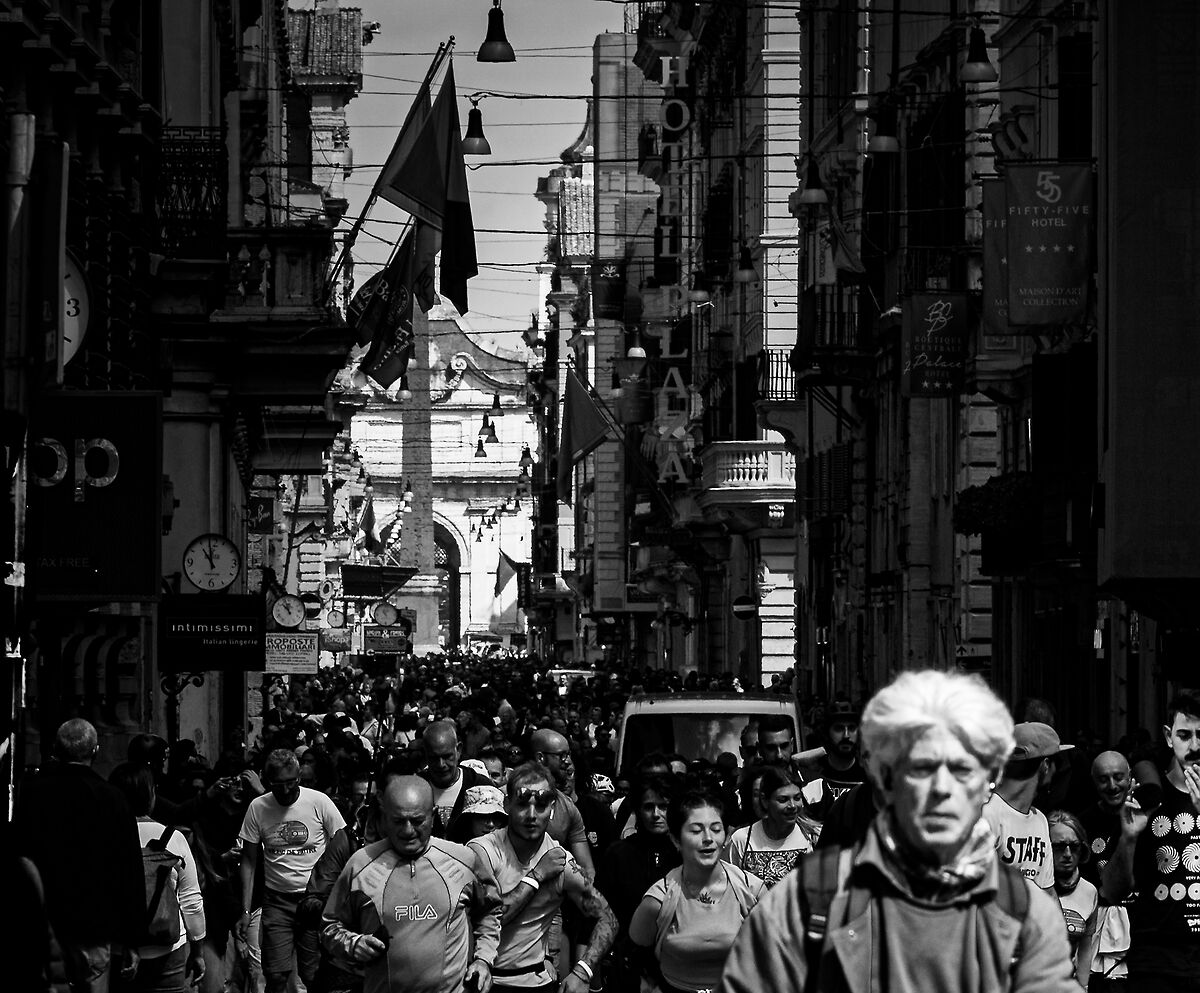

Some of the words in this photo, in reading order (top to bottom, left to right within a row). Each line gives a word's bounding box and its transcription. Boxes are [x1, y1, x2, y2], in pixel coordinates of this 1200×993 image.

[1036, 171, 1062, 203] 55
[1031, 218, 1067, 228] HOTEL
[66, 298, 80, 317] 3
[656, 284, 691, 484] PLAZA
[59, 556, 90, 568] FREE
[172, 624, 253, 632] intimissimi
[1002, 836, 1046, 867] STAFF
[395, 904, 438, 921] FILA
